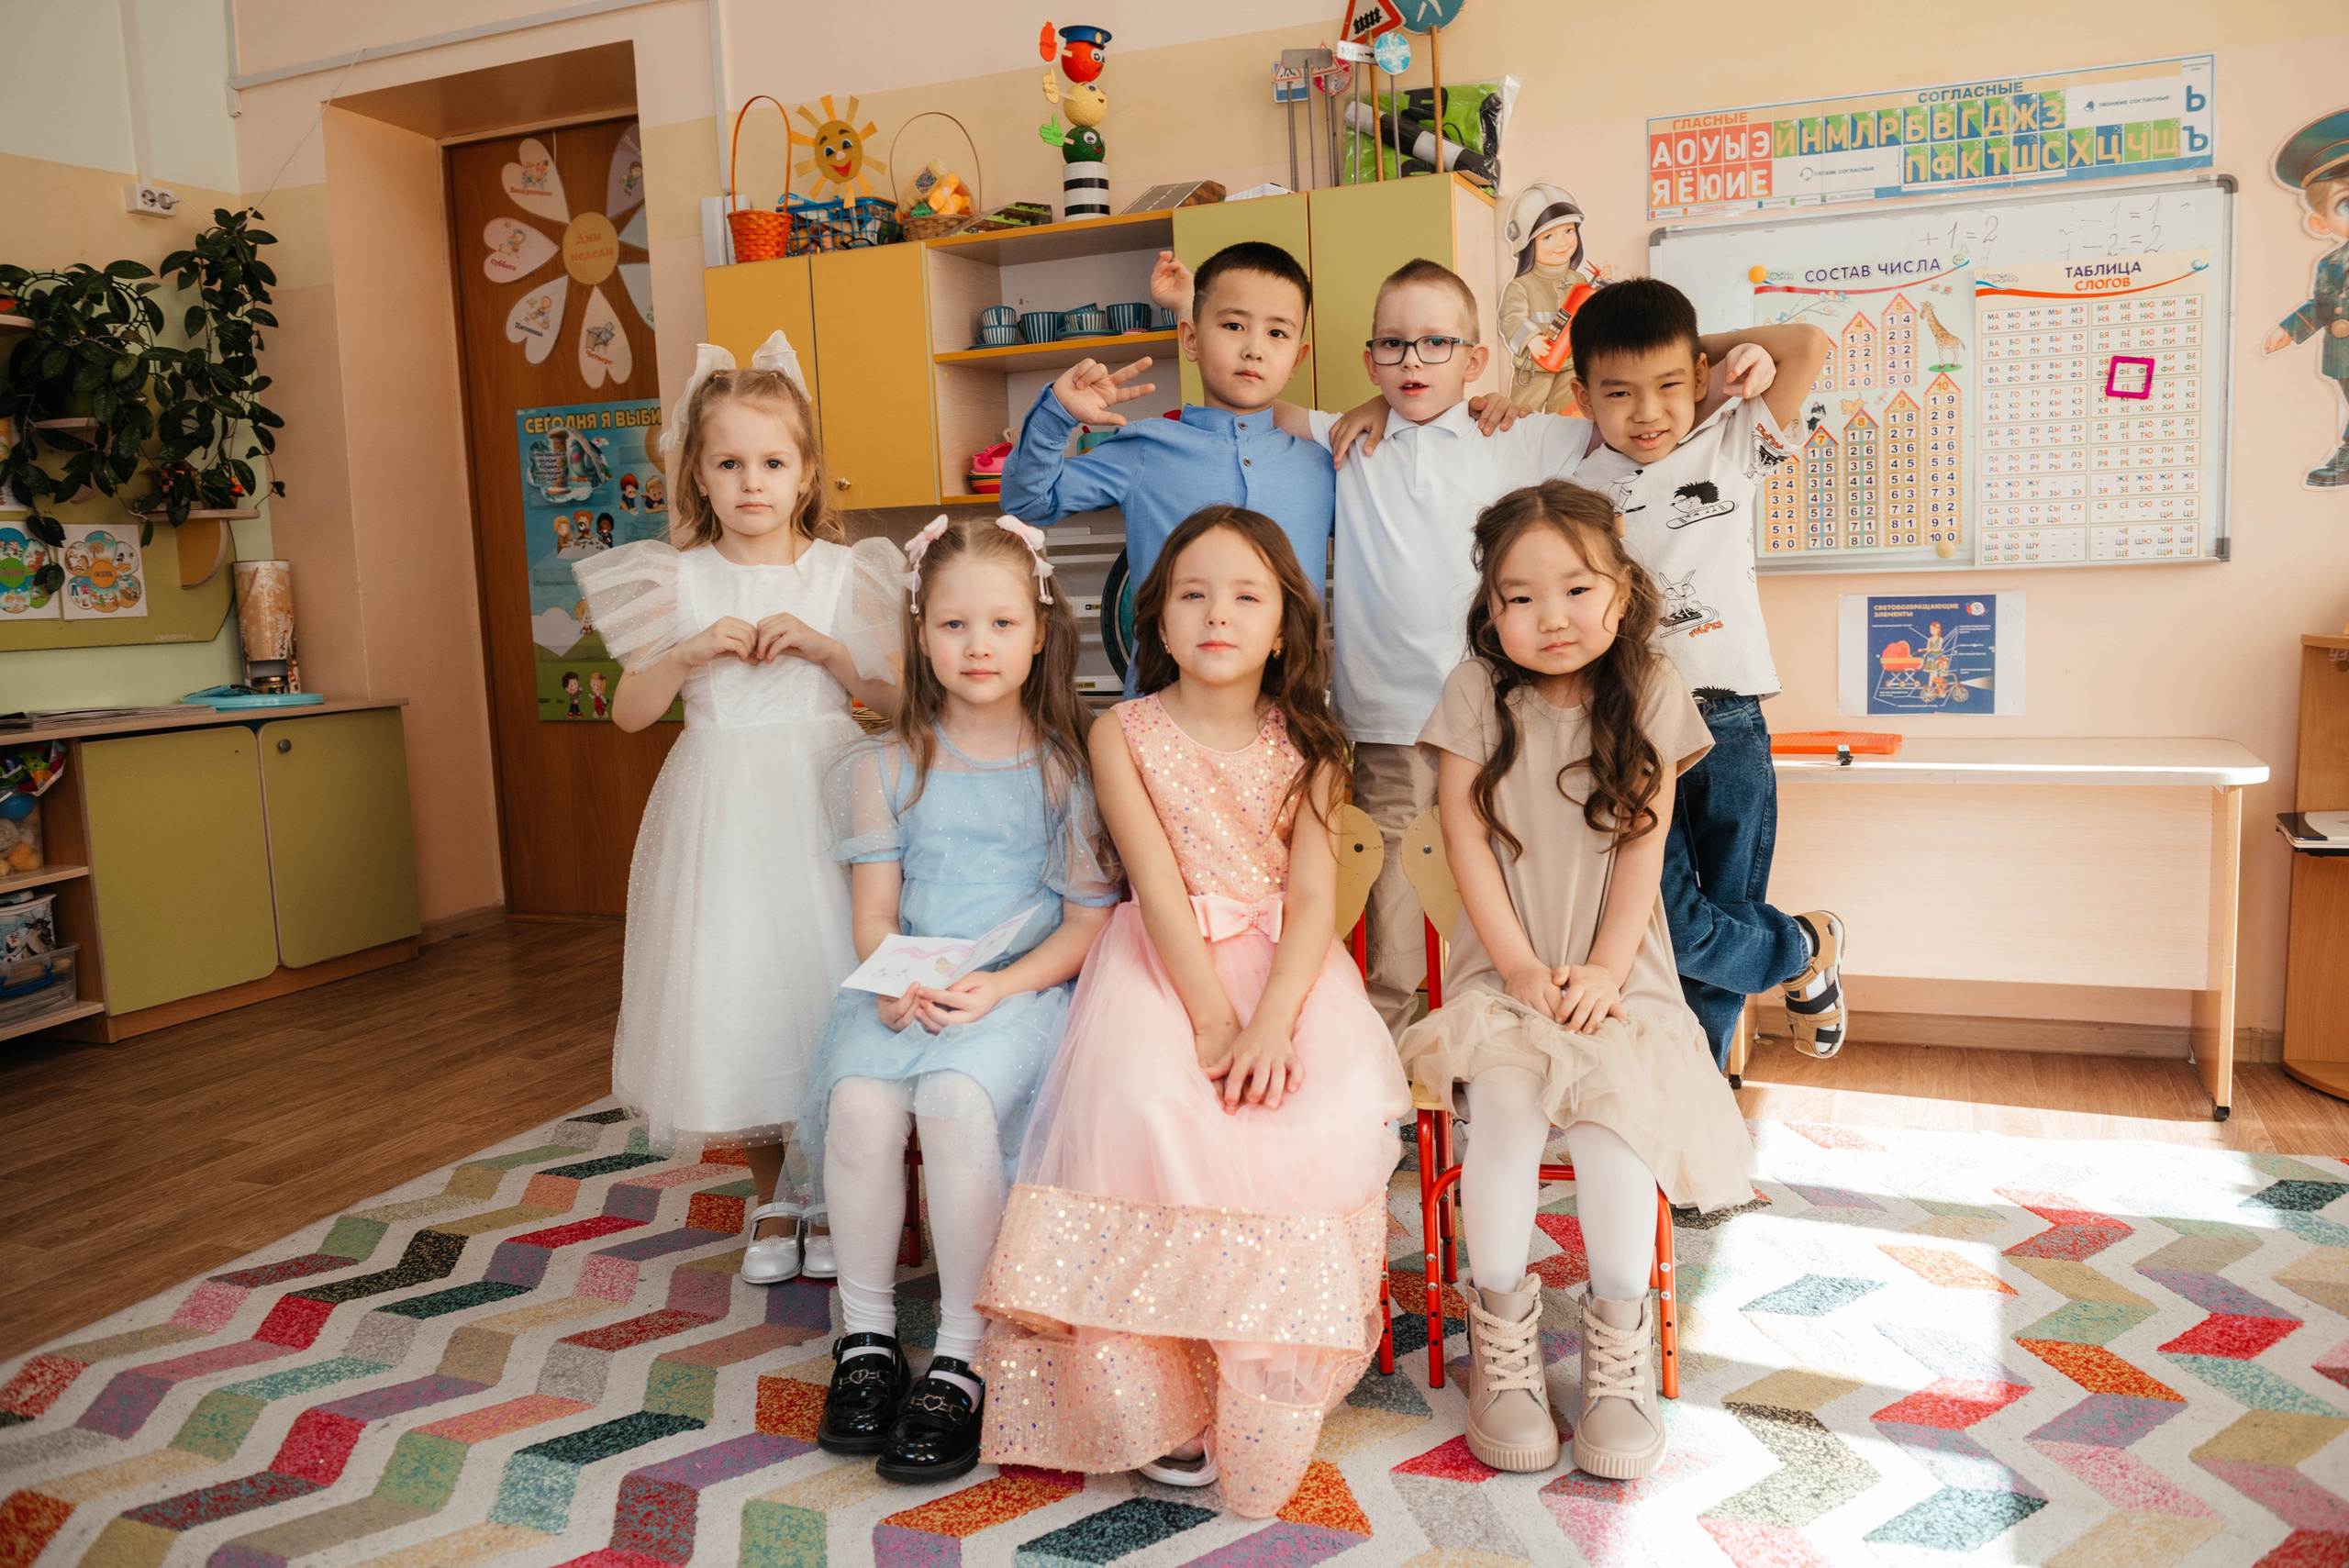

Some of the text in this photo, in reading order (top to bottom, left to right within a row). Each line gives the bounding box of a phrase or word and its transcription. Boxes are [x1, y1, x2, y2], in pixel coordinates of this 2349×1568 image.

[1918, 82, 2023, 103] СОГЛАСНЫЕ
[2130, 95, 2170, 104] СОГЛАСНЫЕ
[1673, 112, 1748, 130] ГЛАСНЫЕ
[1839, 166, 1876, 174] СОГЛАСНЫЕ
[575, 233, 601, 245] Дни
[571, 247, 614, 261] недели
[1805, 263, 1870, 283] СОСТАВ
[1878, 258, 1941, 275] ЧИСЛА
[2065, 261, 2142, 278] ТАБЛИЦА
[2075, 277, 2131, 291] СЛОГОВ
[1897, 302, 1902, 310] 5
[1904, 330, 1910, 339] 3
[1849, 350, 1855, 358] 2
[1889, 361, 1896, 369] 4
[1937, 382, 1948, 390] 10
[1932, 395, 1954, 405] 1 9
[1932, 410, 1954, 420] 2 8
[525, 413, 596, 434] СЕГОДНЯ
[601, 411, 612, 428] Я
[1932, 441, 1954, 450] 4 6
[1932, 457, 1954, 466] 5 5
[1932, 473, 1938, 482] 6
[1948, 487, 1954, 495] 3
[1932, 503, 1954, 512] 8 2
[1932, 517, 1953, 527] 9 1
[1930, 533, 1941, 541] 10
[1874, 603, 1959, 611] СВЕТОВОЗВРАЩАЮЩИЕ
